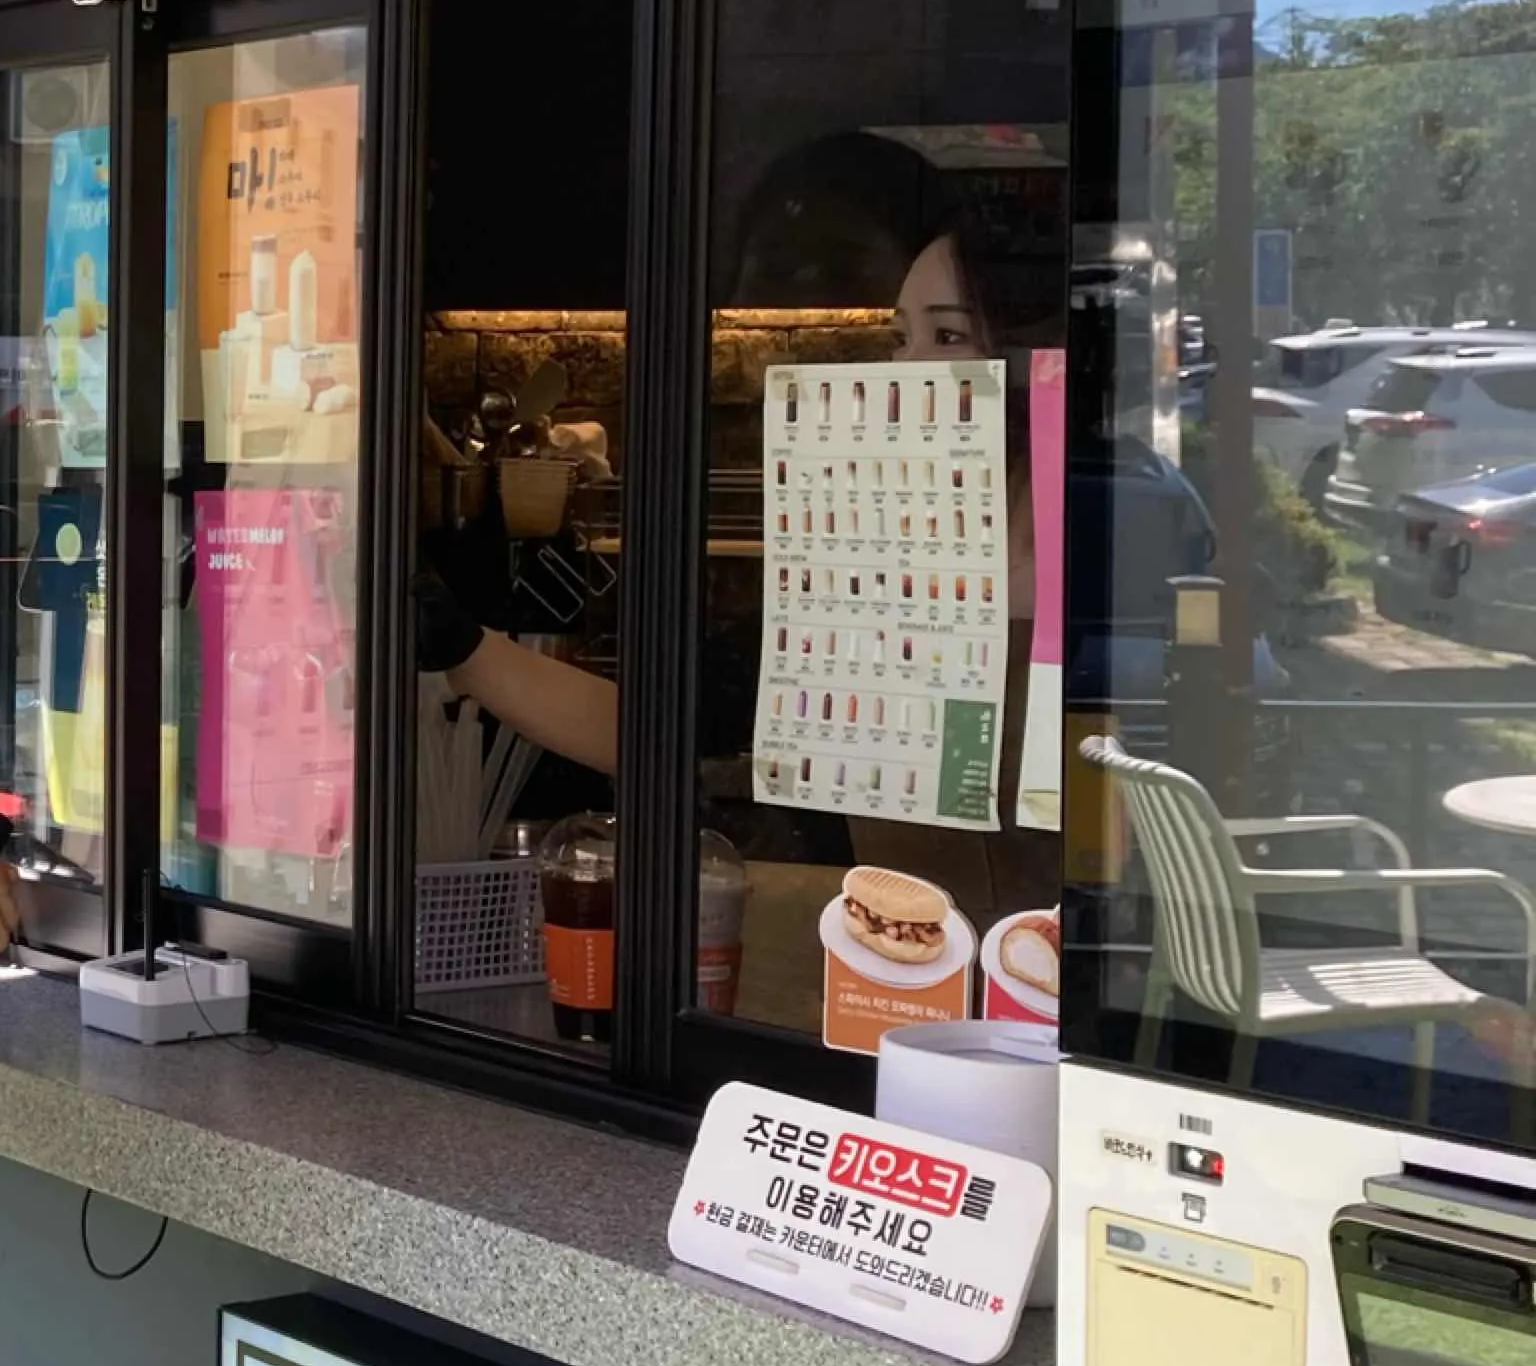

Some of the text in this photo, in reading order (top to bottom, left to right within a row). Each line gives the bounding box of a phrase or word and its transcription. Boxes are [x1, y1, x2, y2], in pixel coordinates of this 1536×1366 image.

[743, 1113, 996, 1222] 주문은 키오스크를
[706, 1201, 735, 1228] 현금
[779, 1224, 853, 1267] 카운터에서
[766, 1175, 932, 1257] 이용해주세요
